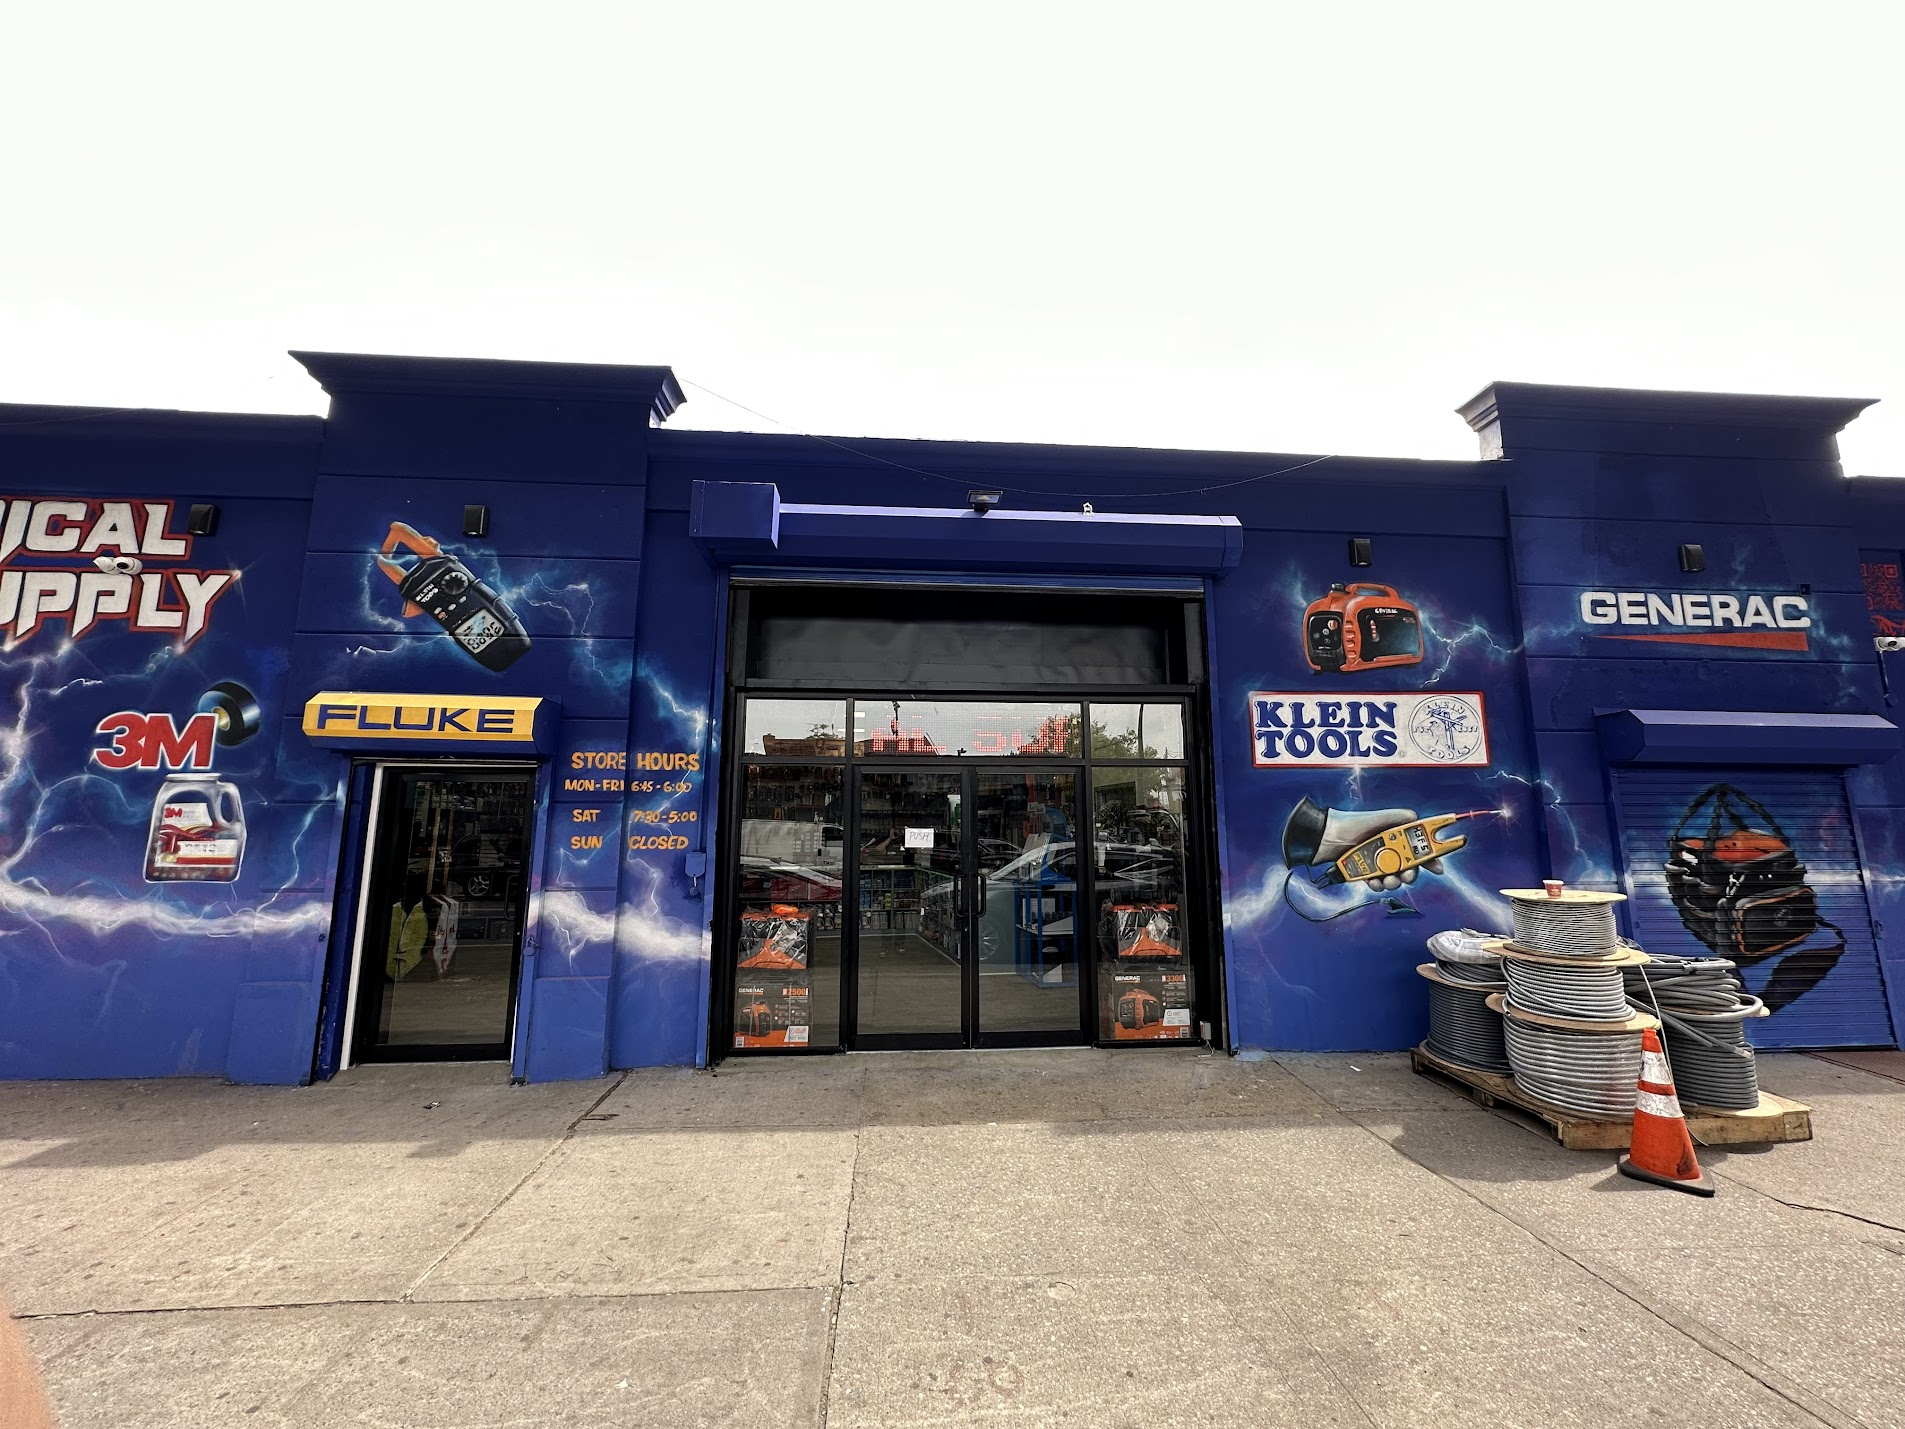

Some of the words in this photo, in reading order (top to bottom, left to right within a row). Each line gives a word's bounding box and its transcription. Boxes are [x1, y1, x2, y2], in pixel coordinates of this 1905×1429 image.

[0, 499, 187, 565] ICAL
[1579, 591, 1811, 628] GENERAC
[317, 704, 515, 733] FLUKE
[1254, 701, 1397, 729] KLEIN
[95, 712, 217, 769] 3M
[1255, 729, 1398, 758] TOOLS
[571, 752, 626, 769] STORE
[637, 753, 700, 771] HOURS
[573, 809, 601, 823] SAT
[570, 836, 603, 849] SUN
[629, 836, 689, 850] CLOSED
